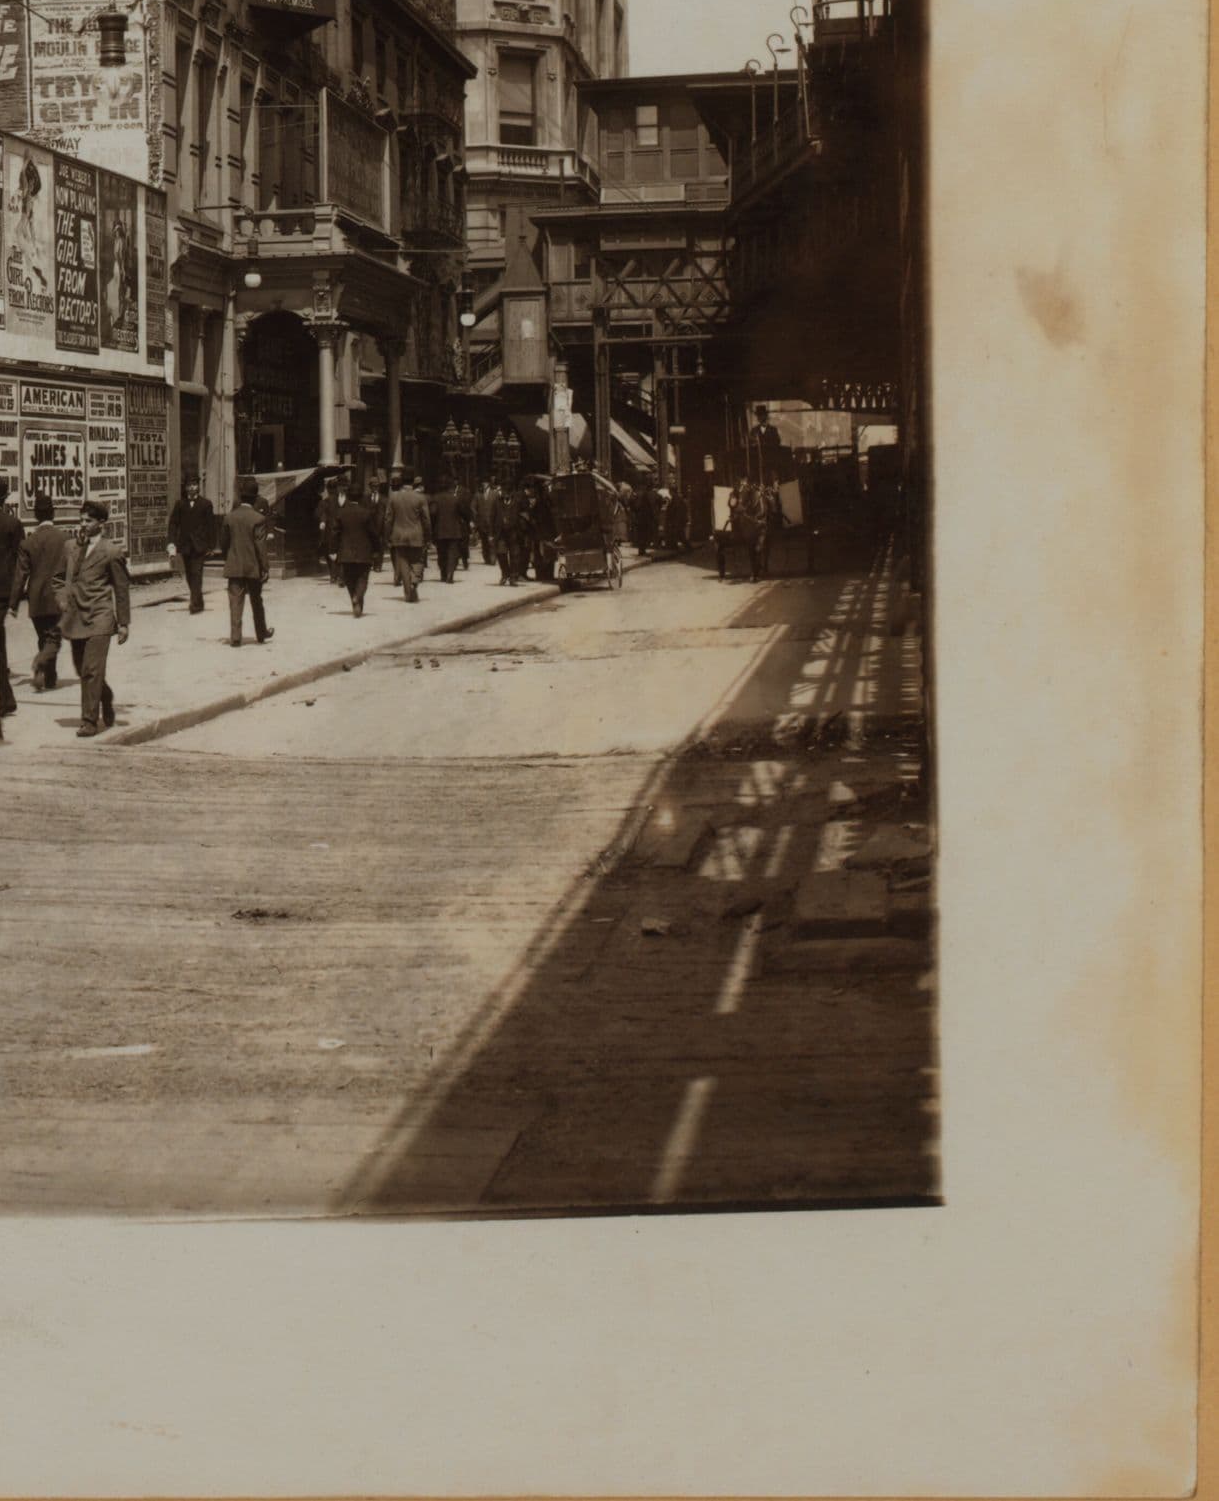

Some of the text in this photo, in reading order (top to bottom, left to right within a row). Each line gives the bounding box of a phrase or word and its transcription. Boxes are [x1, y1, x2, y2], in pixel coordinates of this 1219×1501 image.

[56, 209, 75, 237] THE
[57, 240, 78, 266] GIRL
[58, 268, 87, 296] FROM
[59, 297, 98, 325] RECTOR'S
[23, 388, 83, 408] AMERICAN
[89, 427, 120, 441] RINALDO
[132, 432, 164, 442] VESTA
[31, 444, 81, 466] JAMES J.
[129, 444, 166, 465] TILLEY
[25, 470, 83, 497] JEFFRIES
